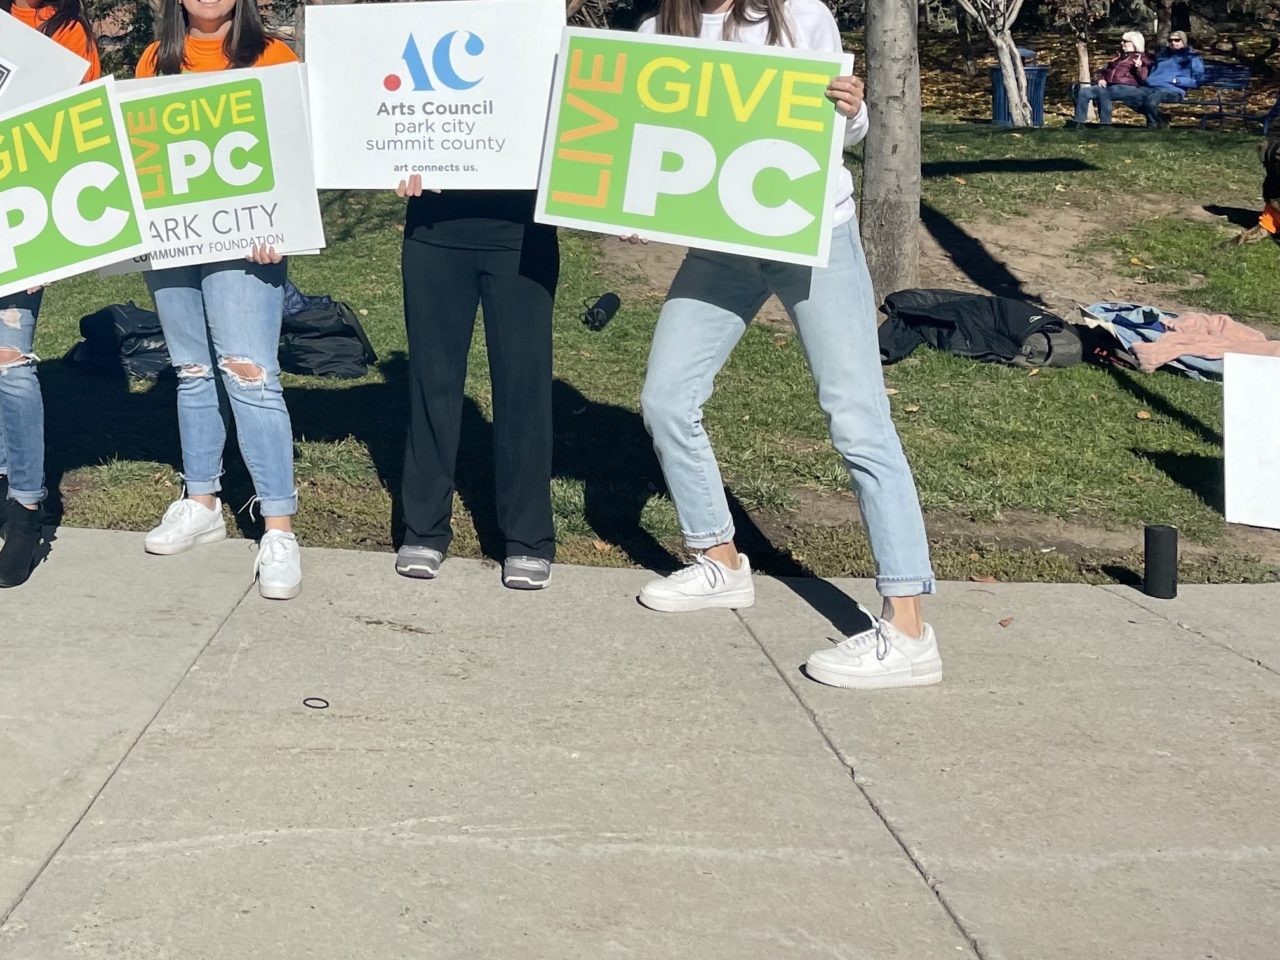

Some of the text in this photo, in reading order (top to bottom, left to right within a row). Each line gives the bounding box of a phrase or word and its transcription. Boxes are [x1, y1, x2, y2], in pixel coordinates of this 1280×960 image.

[162, 89, 256, 135] GIVE
[376, 100, 494, 117] Arts Council
[636, 56, 831, 131] GIVE
[365, 135, 506, 152] summit county
[394, 117, 476, 137] park city
[552, 49, 629, 209] LIVE
[127, 106, 165, 199] LIVE
[167, 131, 263, 195] PC
[393, 162, 478, 173] art connects us.
[622, 123, 821, 237] PC
[149, 202, 278, 243] ARK CITY
[133, 233, 285, 263] COMMUNITY FOUNDATION
